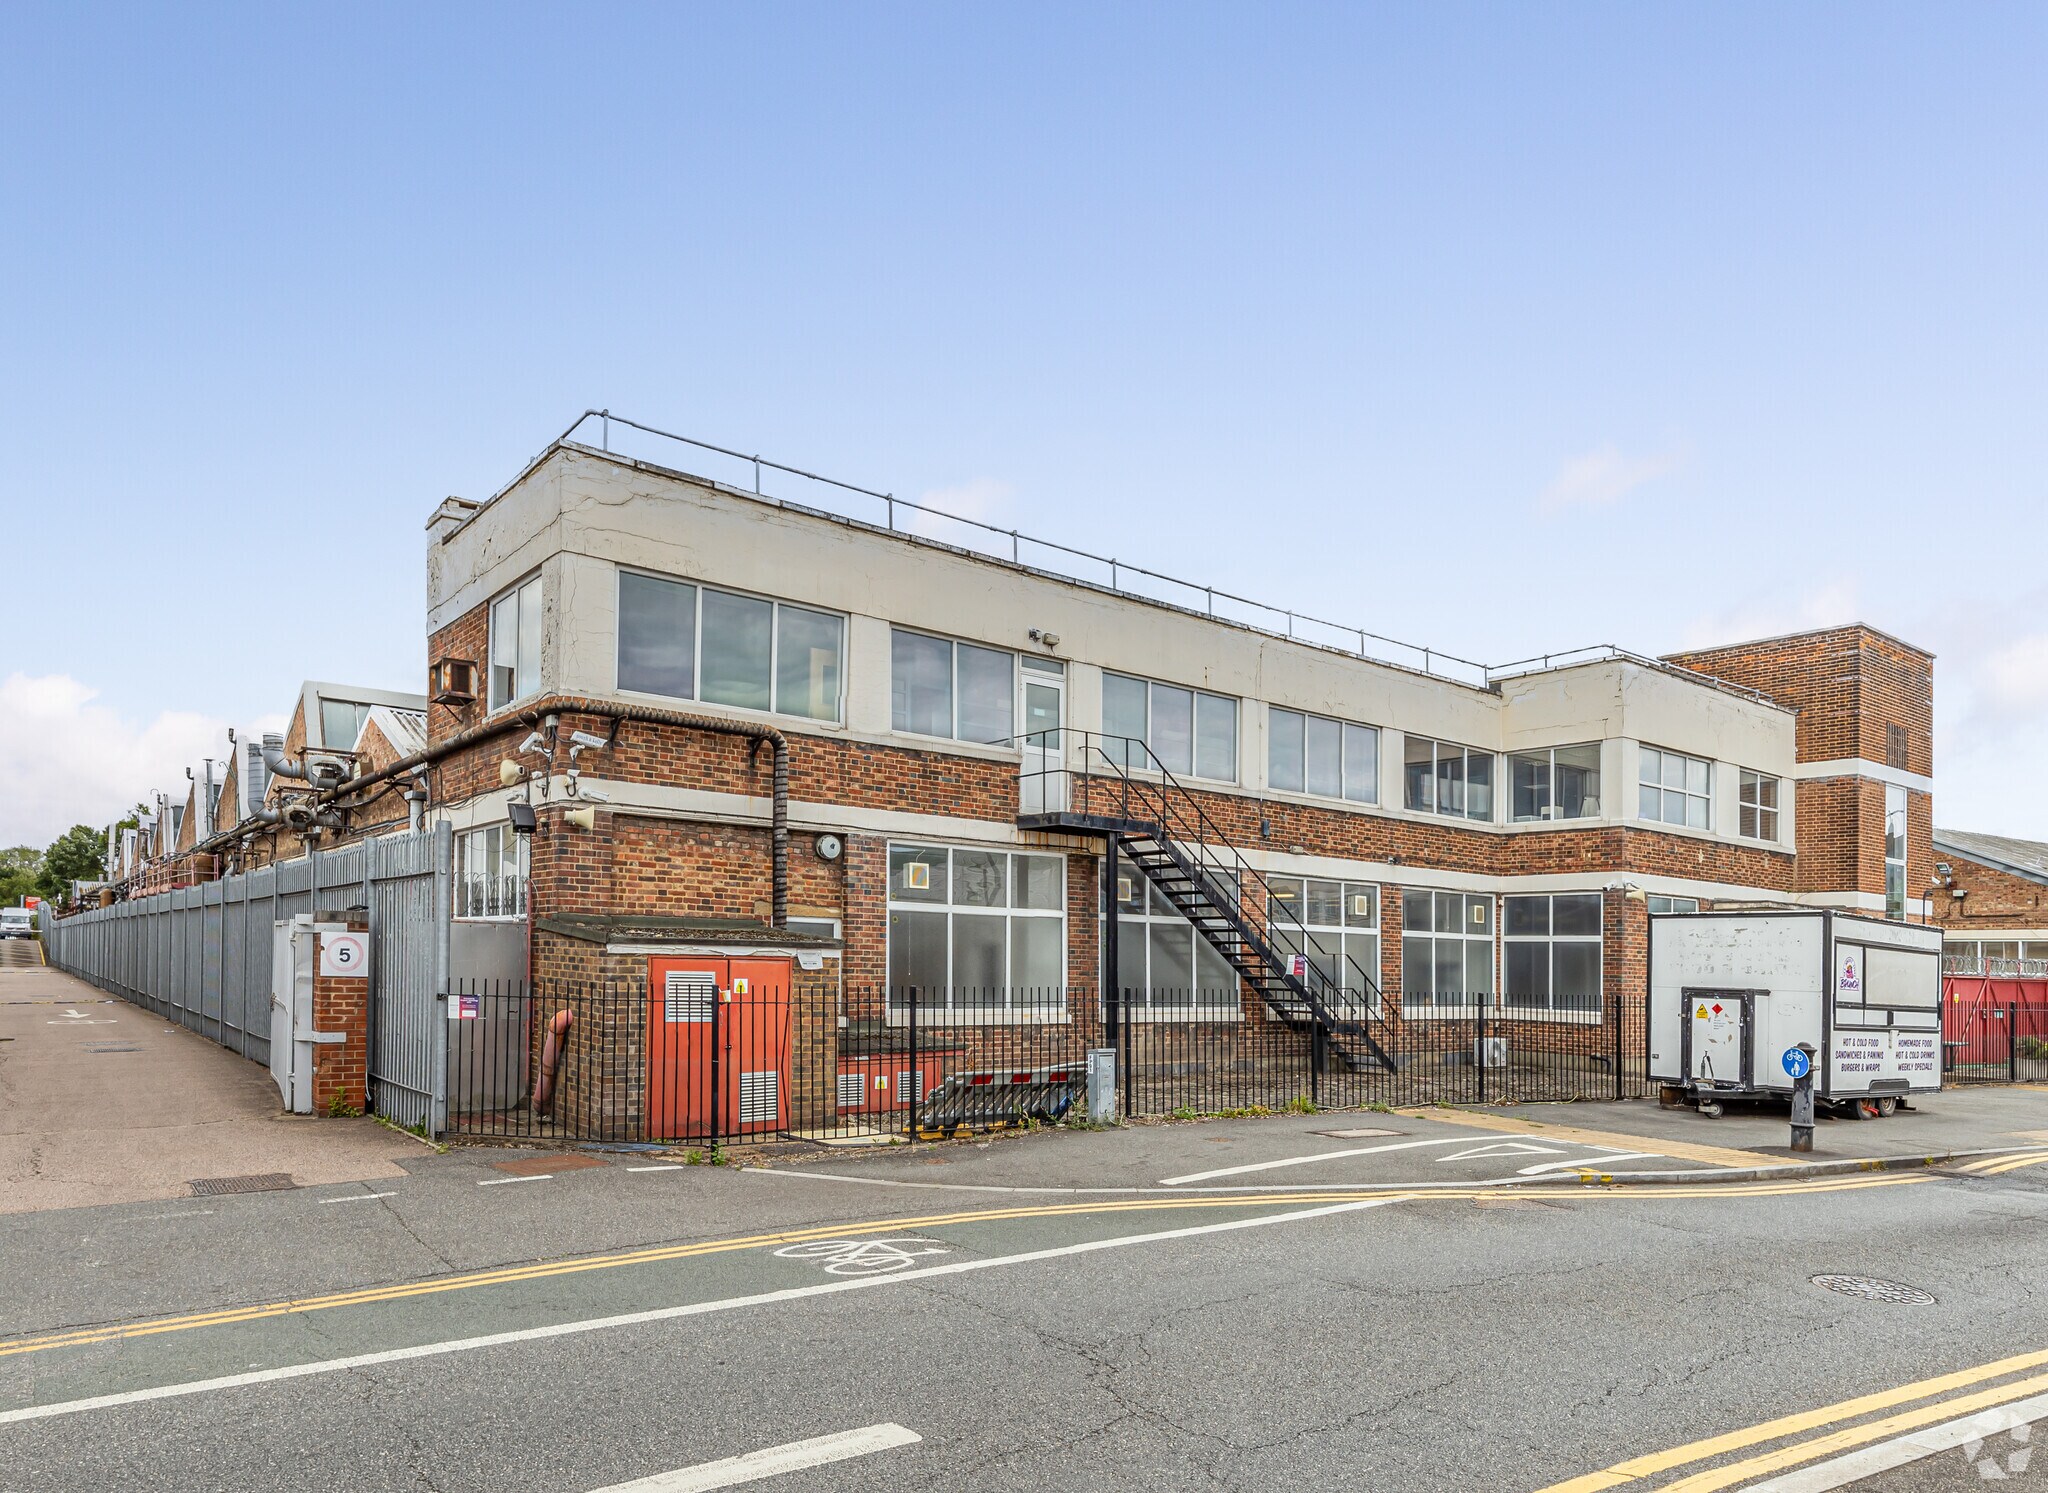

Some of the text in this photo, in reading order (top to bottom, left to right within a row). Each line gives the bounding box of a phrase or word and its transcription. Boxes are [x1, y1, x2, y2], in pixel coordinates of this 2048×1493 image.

[339, 948, 351, 962] 5
[1843, 1038, 1851, 1046] HOT
[1857, 1038, 1867, 1046] COLD
[1869, 1038, 1879, 1047] FOOD
[1898, 1039, 1921, 1047] HOMEMADE
[1835, 1051, 1862, 1059] SANDWICHES
[1867, 1051, 1884, 1059] PANINIS
[1896, 1051, 1904, 1059] HOT
[1909, 1051, 1919, 1059] COLD
[1920, 1051, 1935, 1059] DRINKS
[1841, 1063, 1860, 1072] BURGERS
[1866, 1063, 1880, 1071] WRAPS
[1898, 1063, 1914, 1071] WEEKLY
